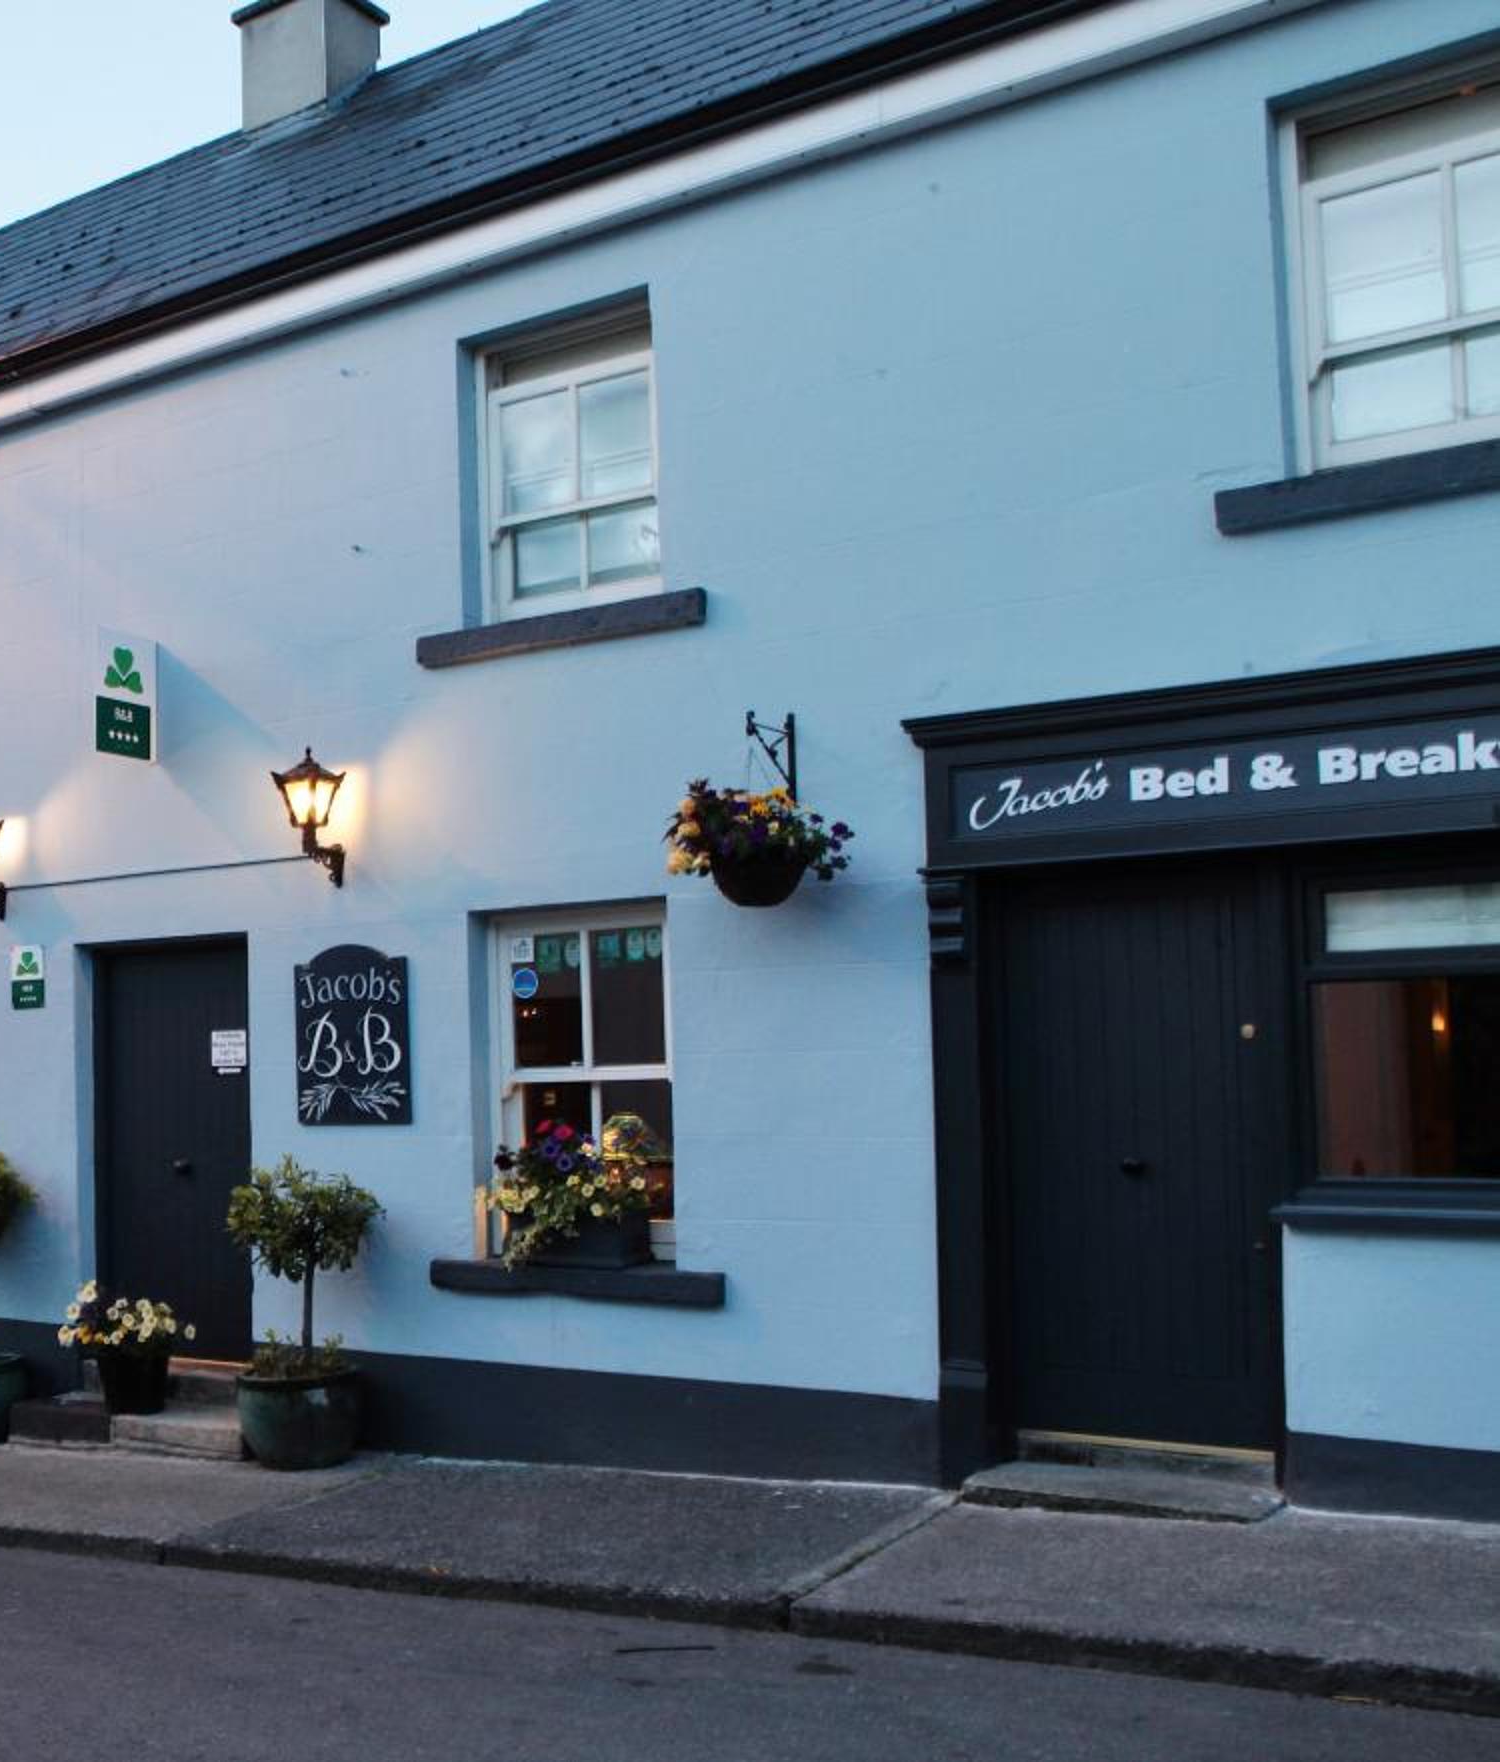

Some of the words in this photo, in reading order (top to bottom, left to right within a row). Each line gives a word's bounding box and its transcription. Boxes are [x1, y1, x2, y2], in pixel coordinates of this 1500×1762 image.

[969, 759, 1109, 830] Jacob's
[1130, 756, 1229, 803] Bed
[1250, 754, 1297, 791] &
[299, 967, 401, 1009] Jacob's
